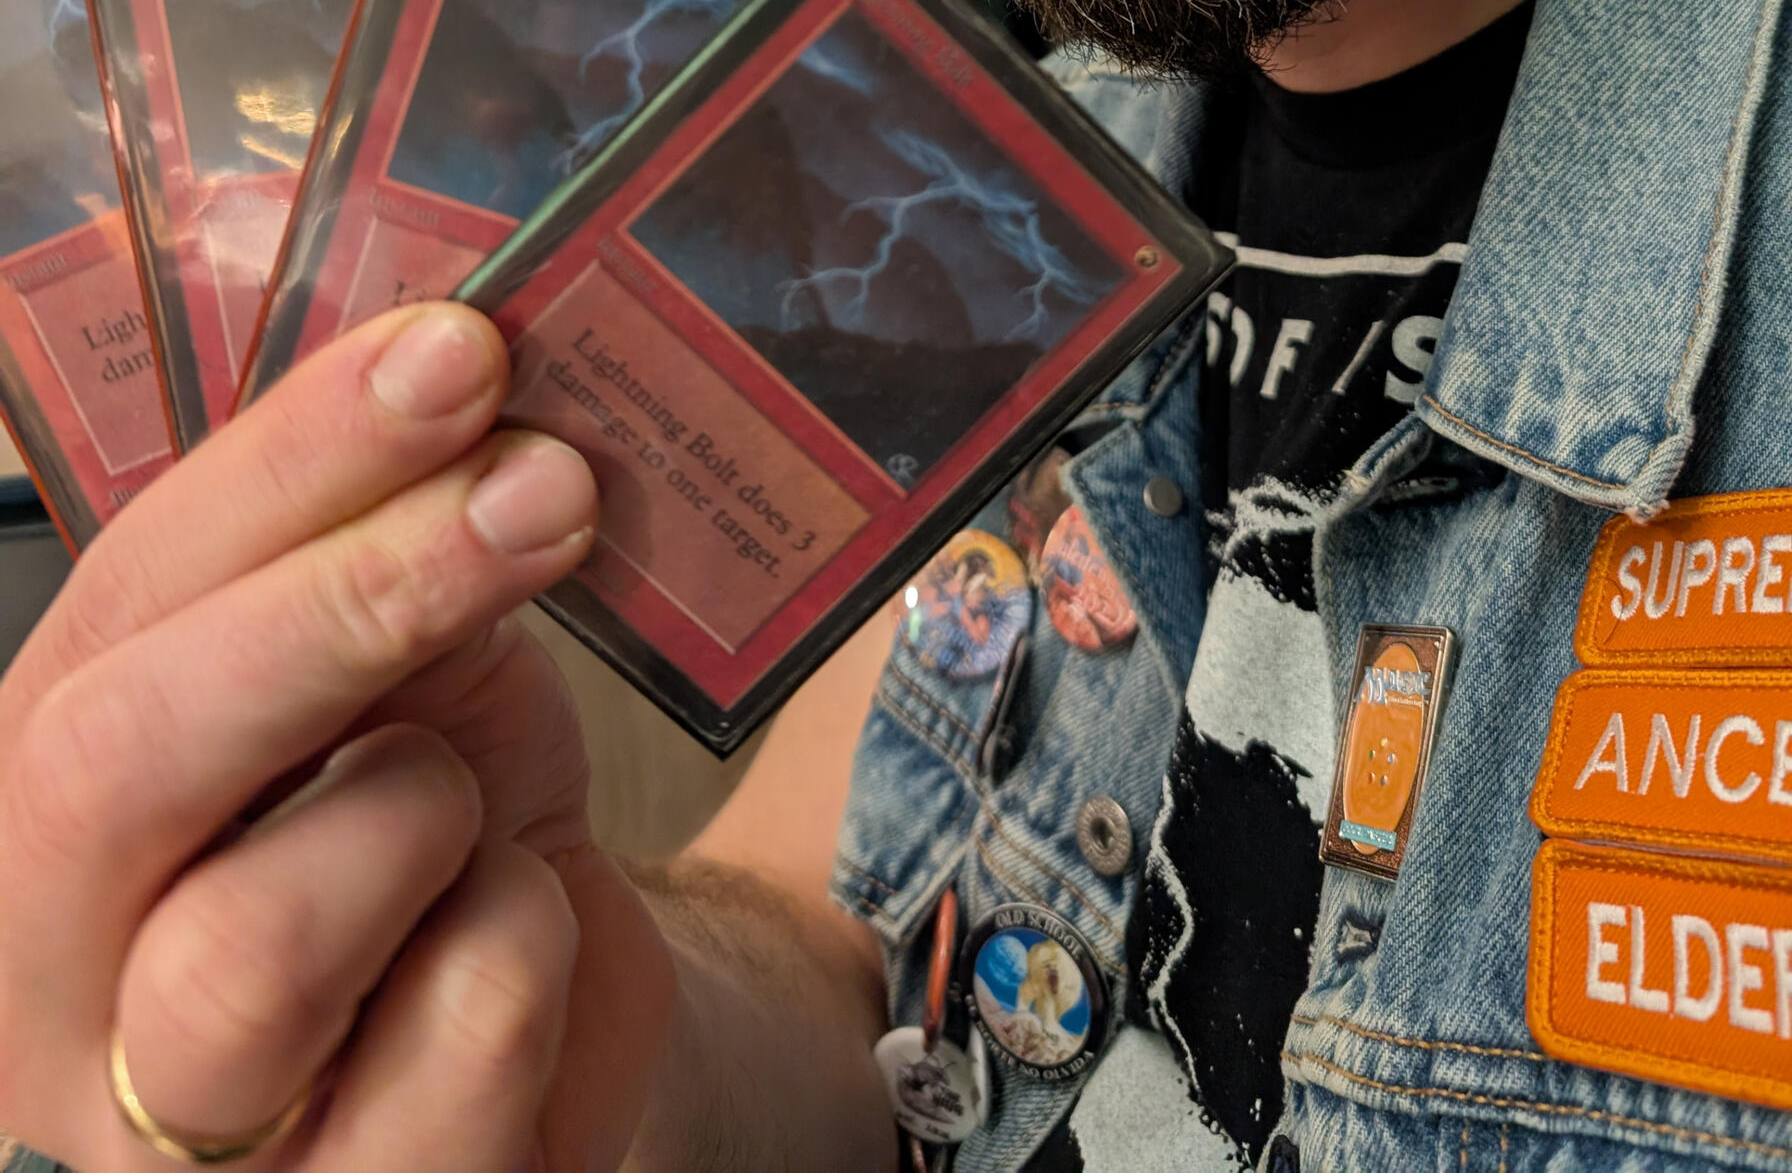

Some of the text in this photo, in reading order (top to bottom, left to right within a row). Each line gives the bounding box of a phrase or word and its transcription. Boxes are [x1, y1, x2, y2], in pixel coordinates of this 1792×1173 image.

[546, 359, 781, 579] damage to one target.
[573, 327, 817, 552] Lightning Bolt does 3
[1611, 534, 1792, 620] SUPRE
[995, 909, 1082, 960] OLD SCHOOL
